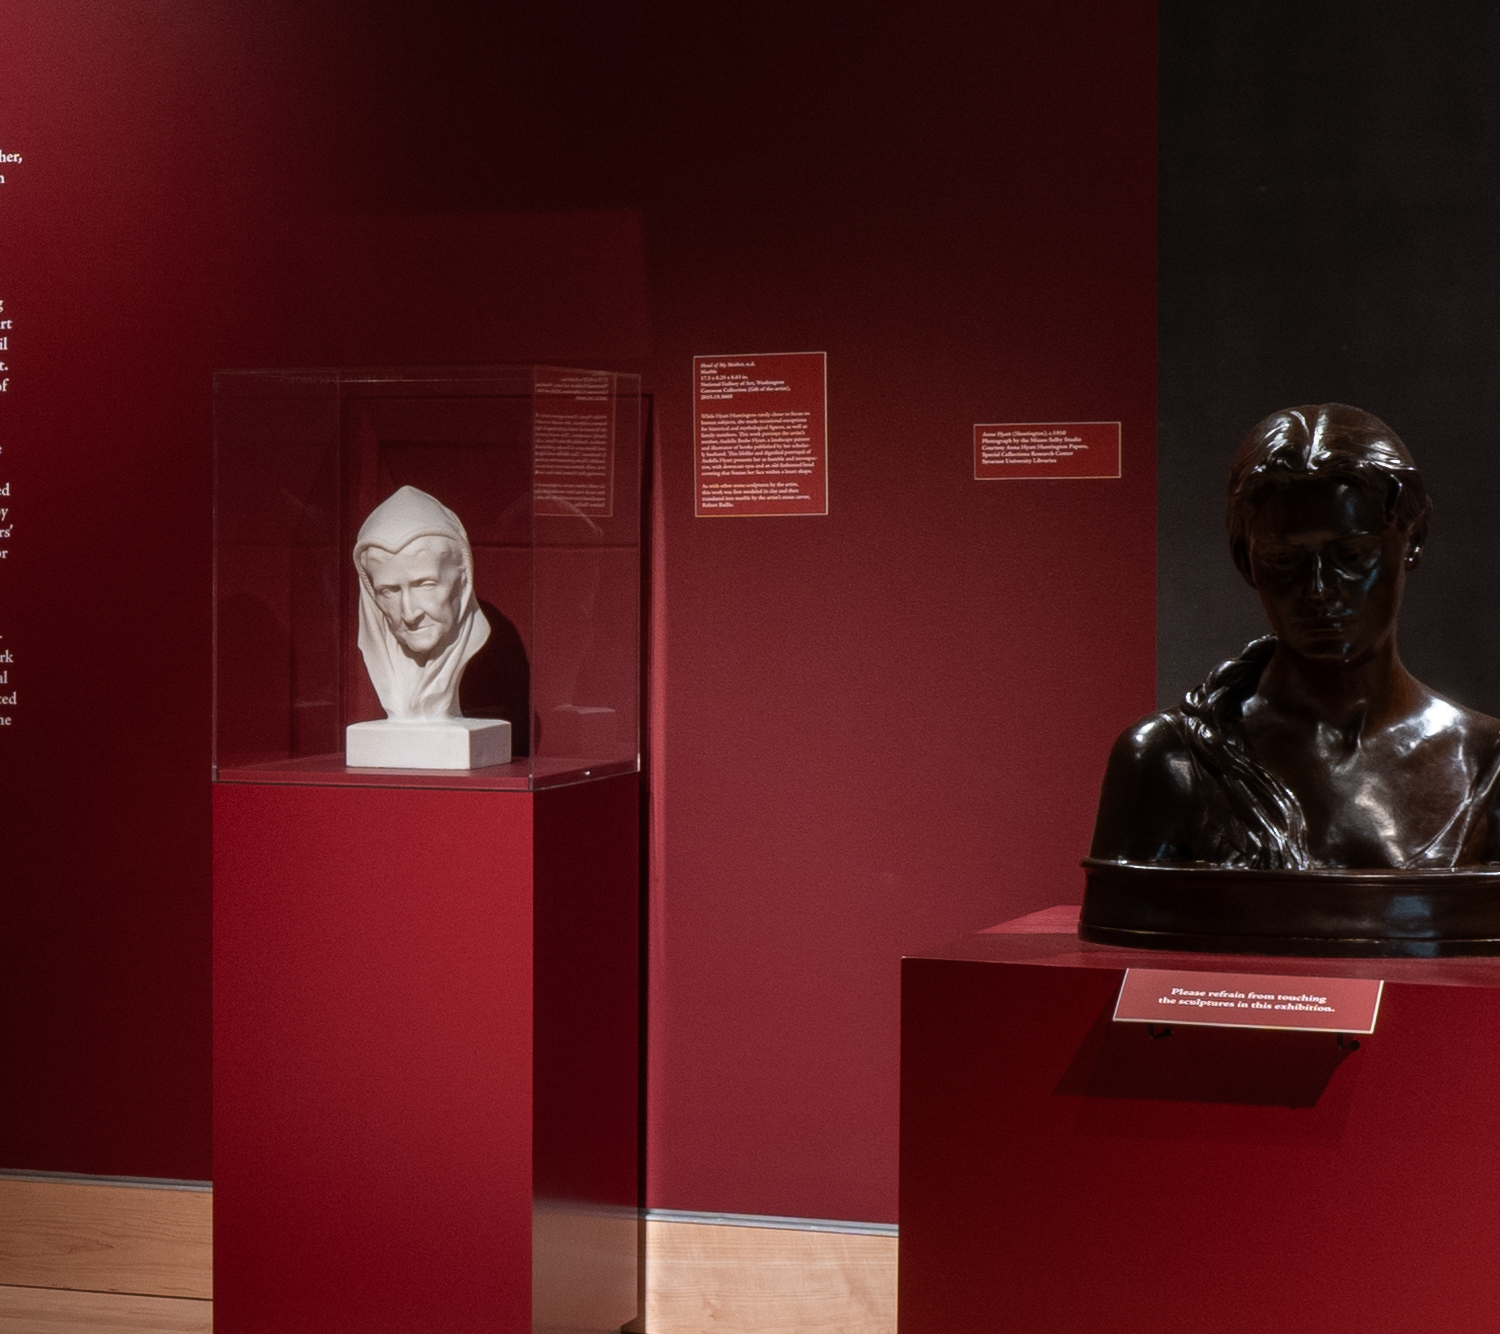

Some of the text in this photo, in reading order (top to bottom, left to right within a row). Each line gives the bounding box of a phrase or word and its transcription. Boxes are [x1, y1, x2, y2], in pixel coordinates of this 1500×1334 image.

[1172, 987, 1327, 1003] Please refrain from touching
[1158, 996, 1335, 1012] the sculptures in this exhibition.
